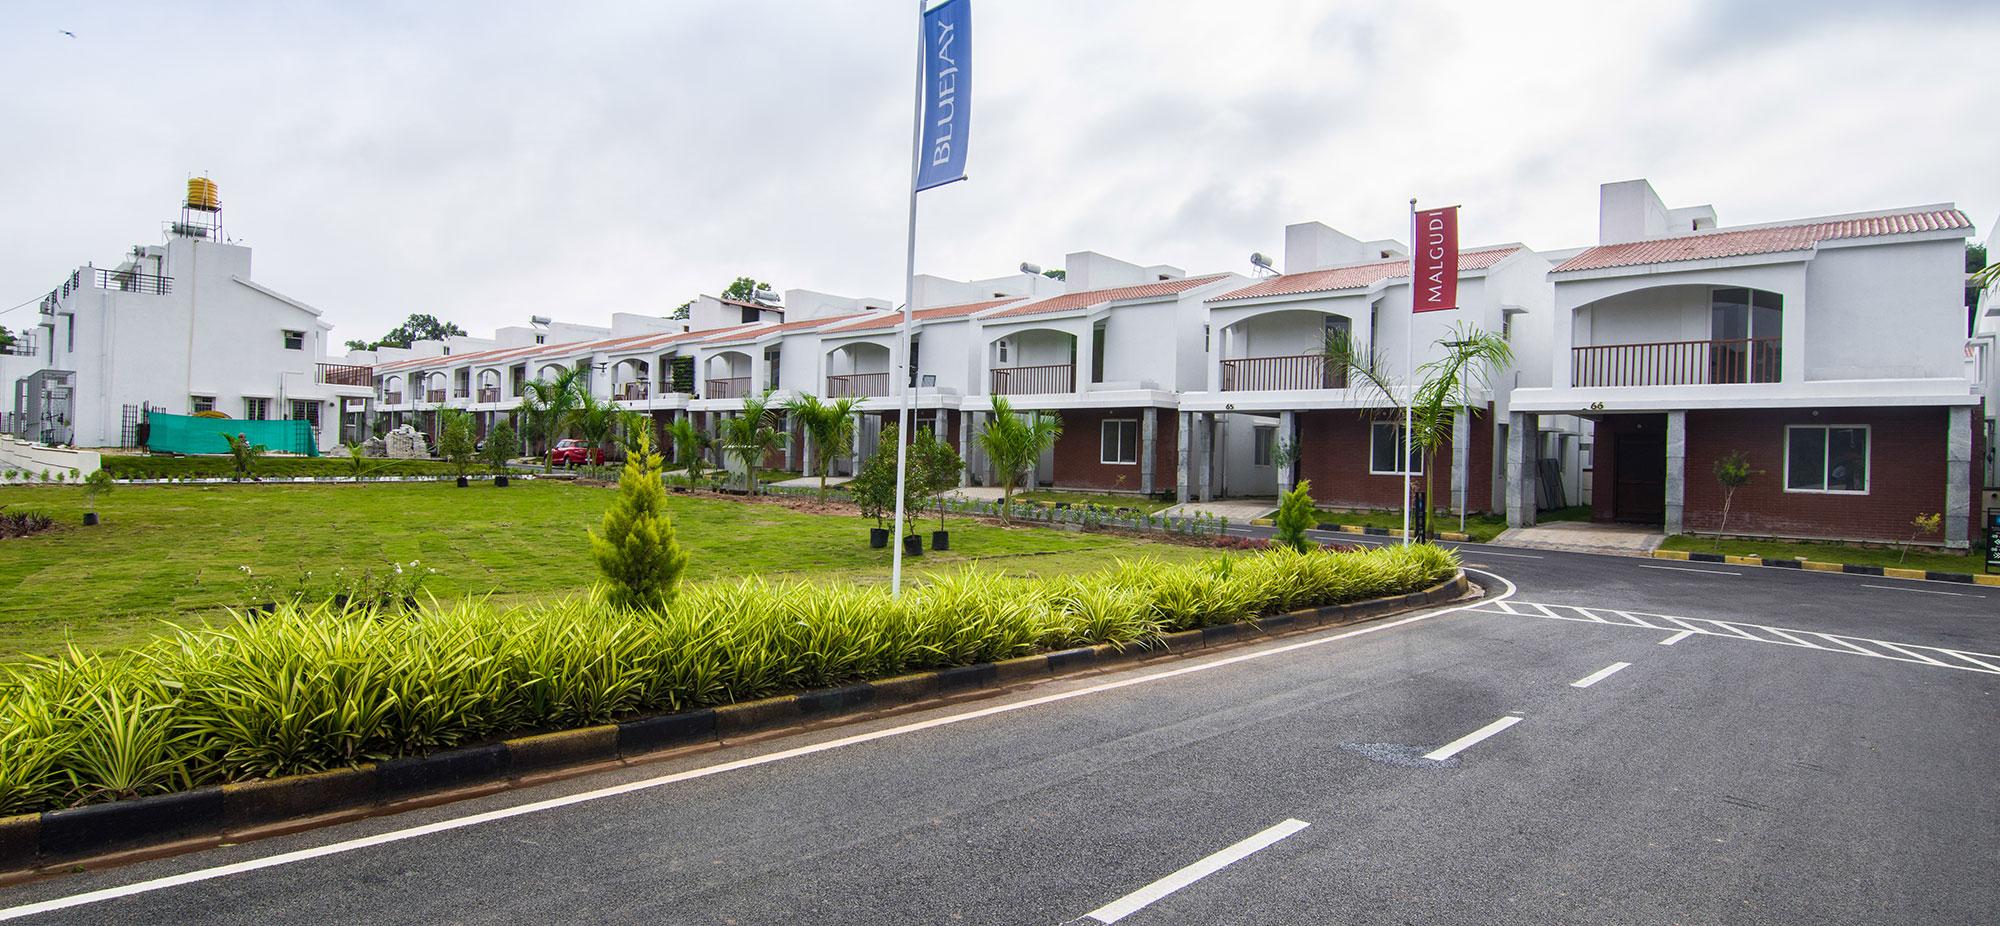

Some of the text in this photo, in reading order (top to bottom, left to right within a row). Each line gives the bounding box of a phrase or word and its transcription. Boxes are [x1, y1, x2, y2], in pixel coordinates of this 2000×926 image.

[933, 21, 958, 167] BLUEJAY
[1428, 211, 1444, 302] MALGUDI
[1590, 401, 1604, 410] 66
